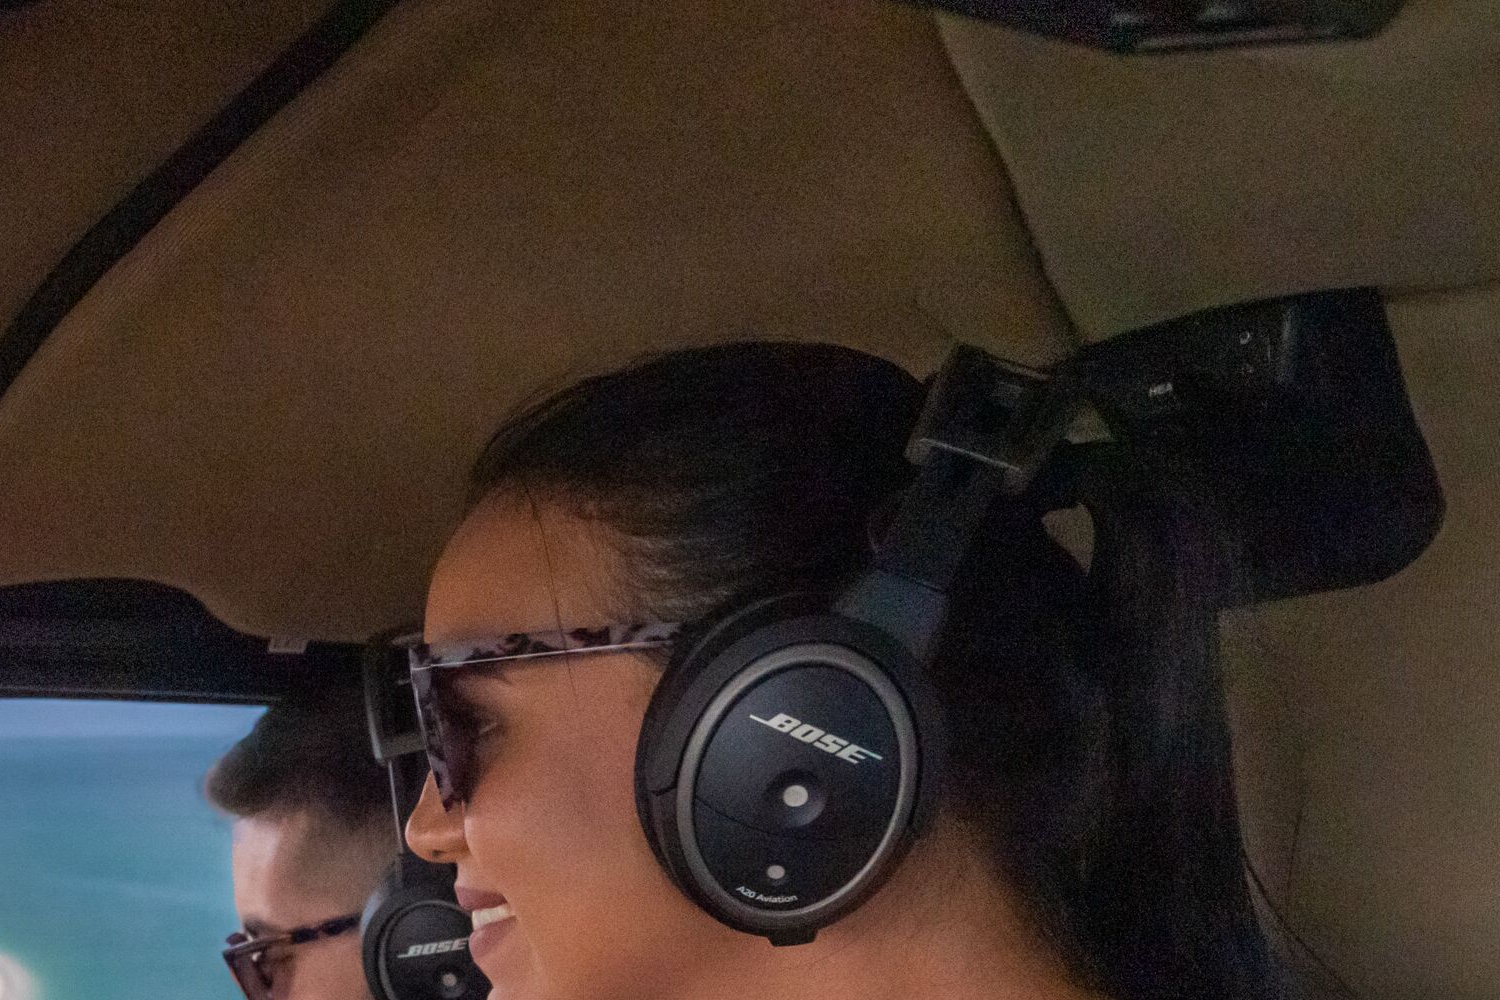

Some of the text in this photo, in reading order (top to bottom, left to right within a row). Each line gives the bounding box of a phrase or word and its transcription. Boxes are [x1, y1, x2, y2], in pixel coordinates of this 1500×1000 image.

[749, 712, 883, 765] BOSE
[735, 886, 798, 904] A20 Aviation
[397, 937, 469, 958] BOSE
